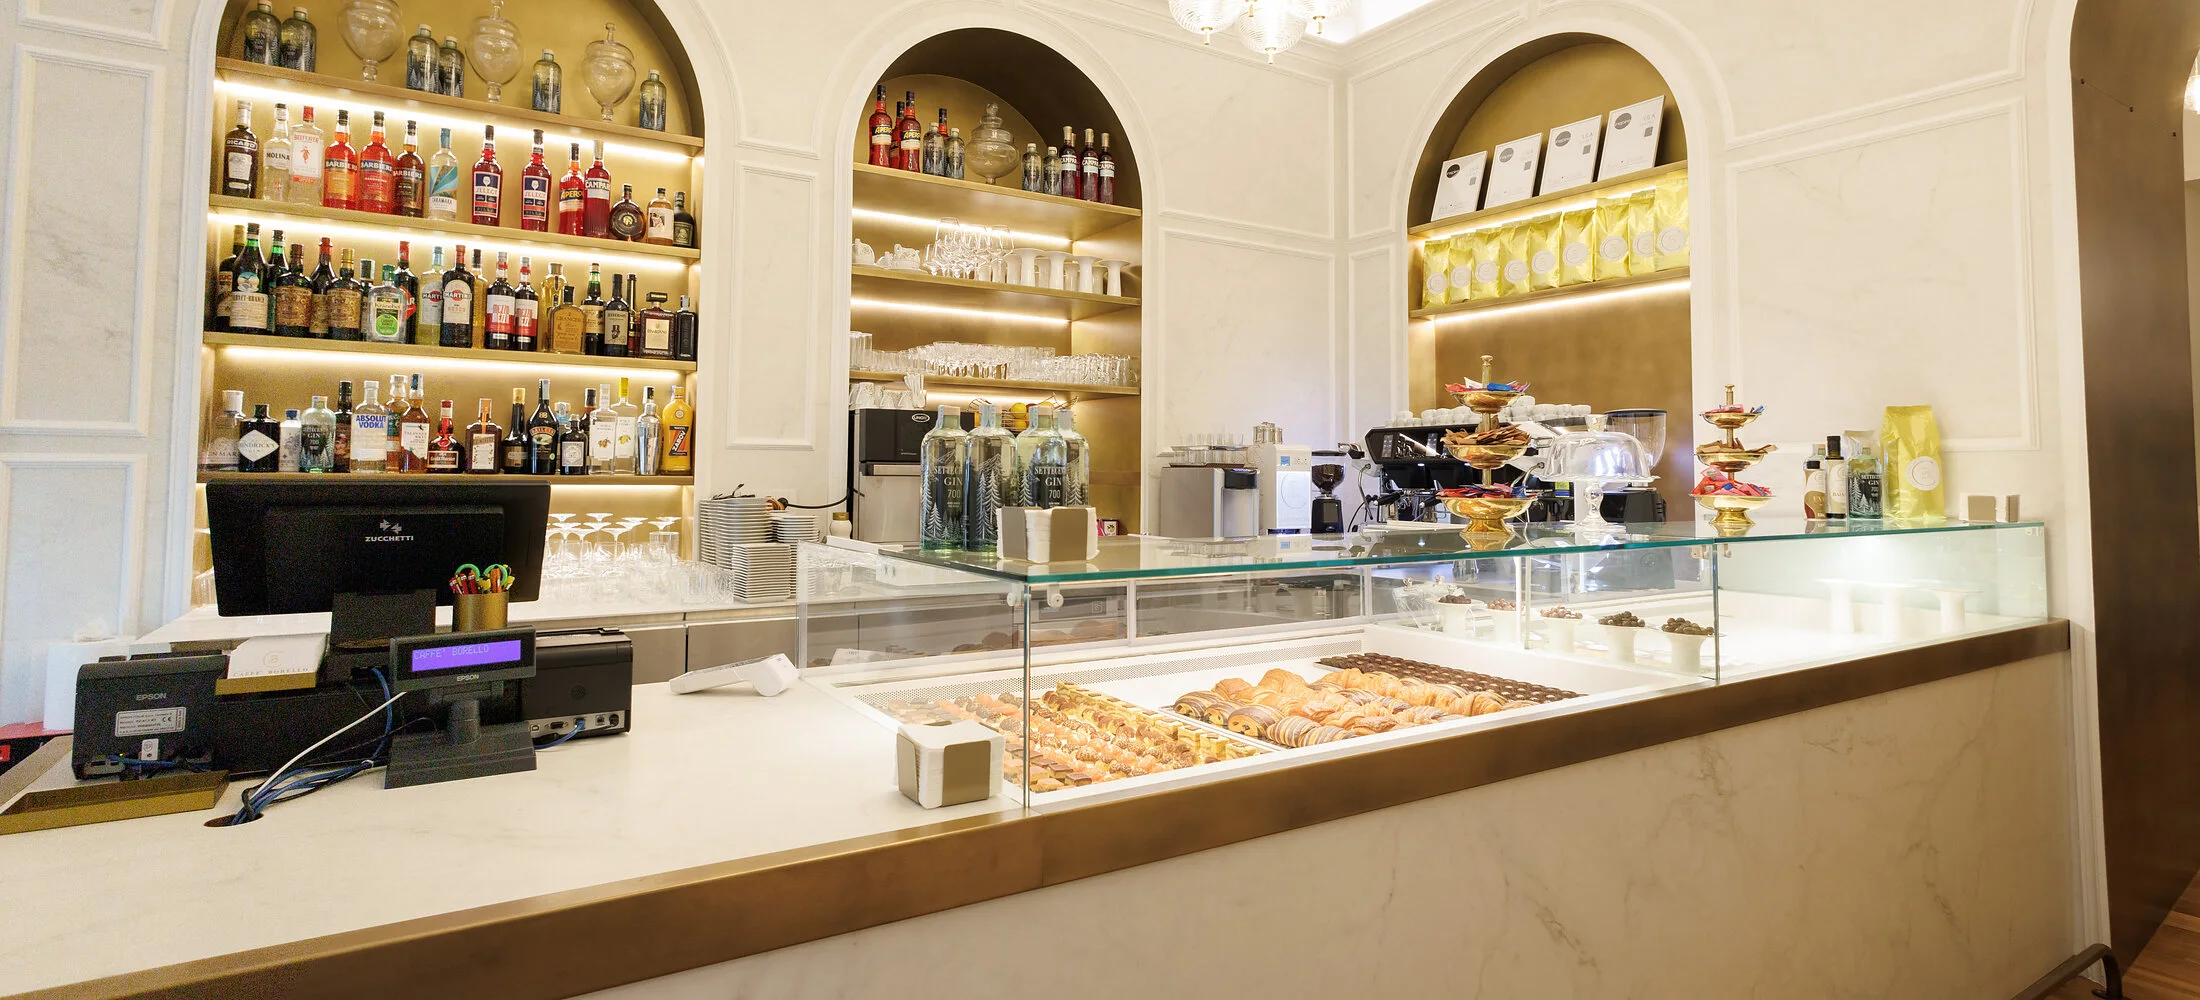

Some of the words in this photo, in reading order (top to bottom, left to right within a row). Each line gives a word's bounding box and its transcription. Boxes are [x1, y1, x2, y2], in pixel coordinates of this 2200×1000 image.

[266, 152, 290, 160] MOLINA
[561, 190, 583, 199] APERO
[358, 421, 385, 429] VODKA
[671, 430, 686, 452] ZABOV
[943, 477, 963, 486] GIN
[1045, 477, 1062, 486] GIN
[947, 490, 960, 499] 700
[1048, 489, 1061, 499] 700
[452, 644, 490, 656] BORELLO
[457, 674, 480, 682] EPSON
[136, 692, 167, 701] EPSON
